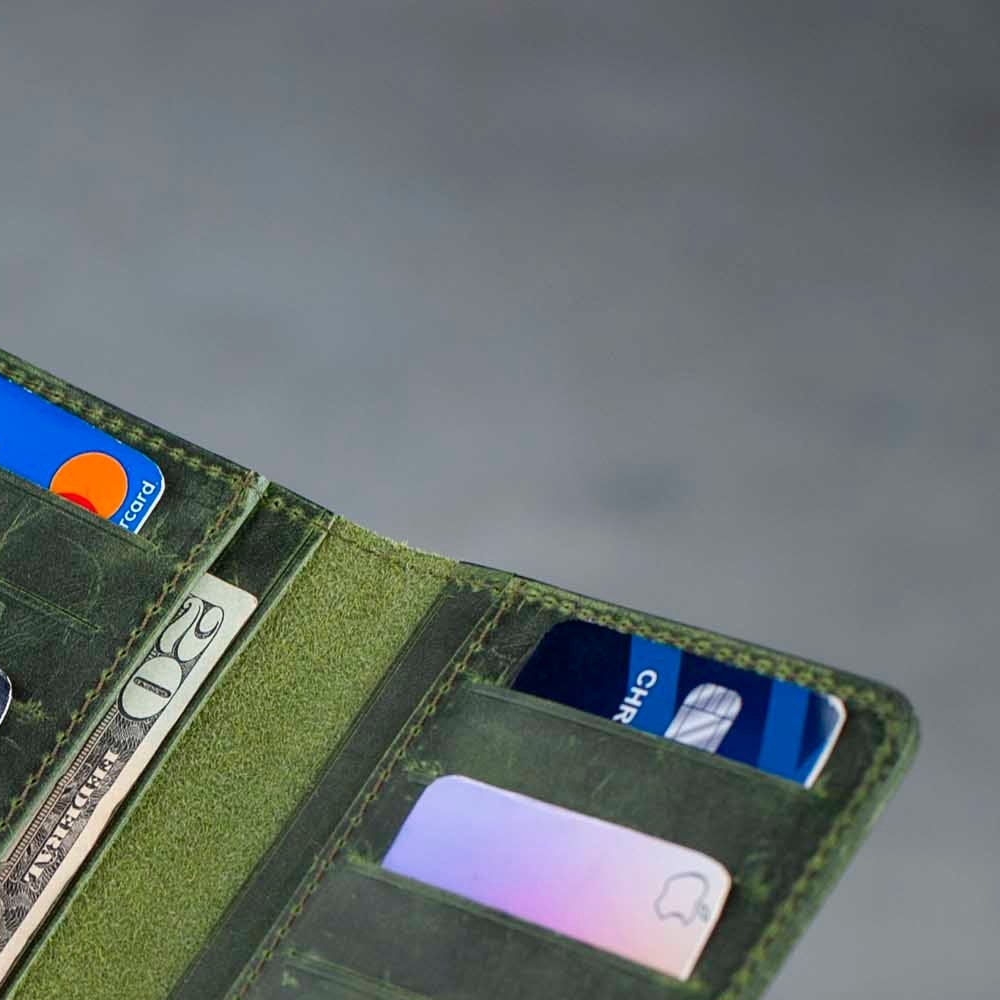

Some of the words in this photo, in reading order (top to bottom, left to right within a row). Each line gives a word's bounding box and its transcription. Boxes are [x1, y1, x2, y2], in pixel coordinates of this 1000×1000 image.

[119, 480, 156, 529] rcard
[116, 596, 226, 721] 20
[612, 669, 658, 724] CHR
[23, 749, 121, 882] FEDERAL
